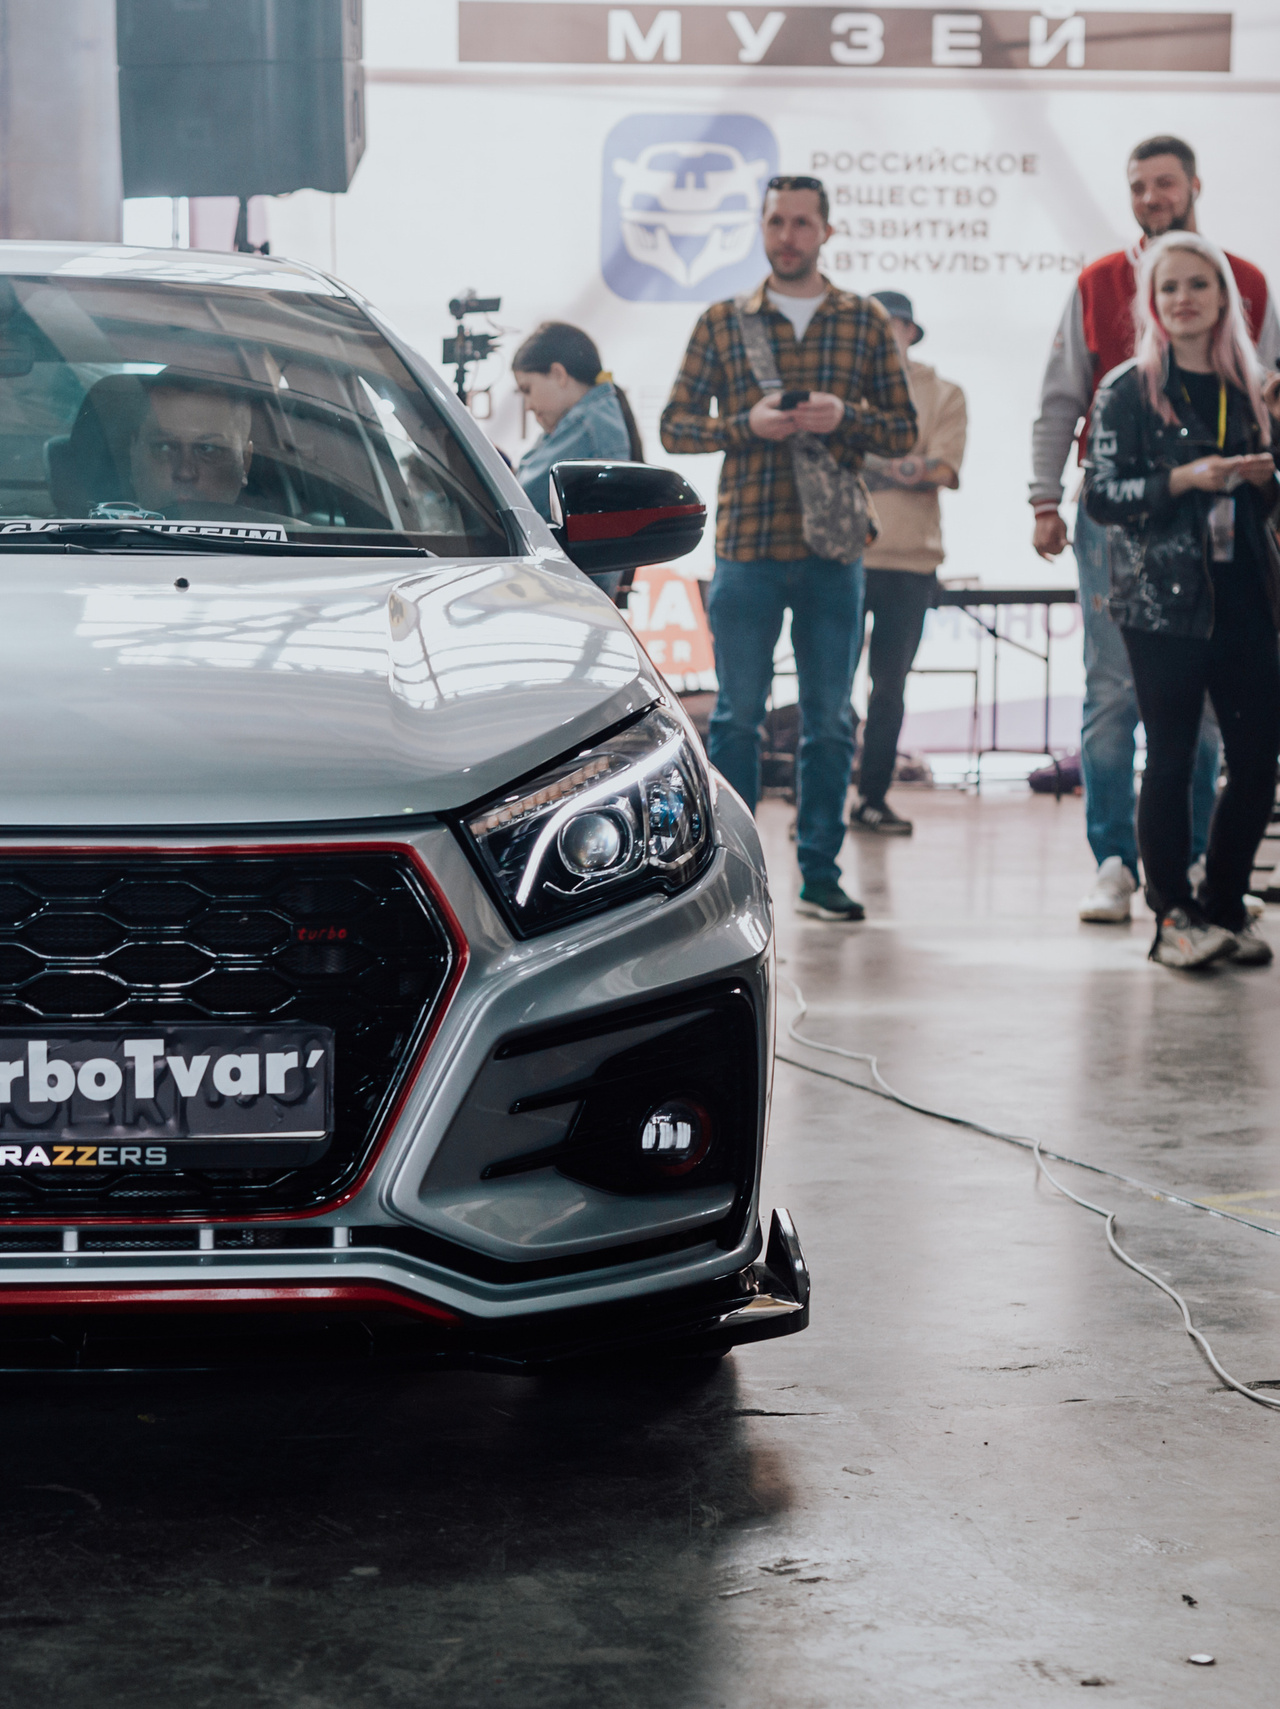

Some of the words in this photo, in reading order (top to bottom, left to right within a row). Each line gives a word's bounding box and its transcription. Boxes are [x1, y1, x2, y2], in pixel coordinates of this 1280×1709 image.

[607, 5, 1086, 67] МУЗЕЙ
[811, 148, 1039, 174] РОССИЙСКОЕ
[834, 185, 998, 208] БЩЕСТВО
[834, 218, 989, 239] АЗВИТИЯ
[297, 926, 348, 940] turbo
